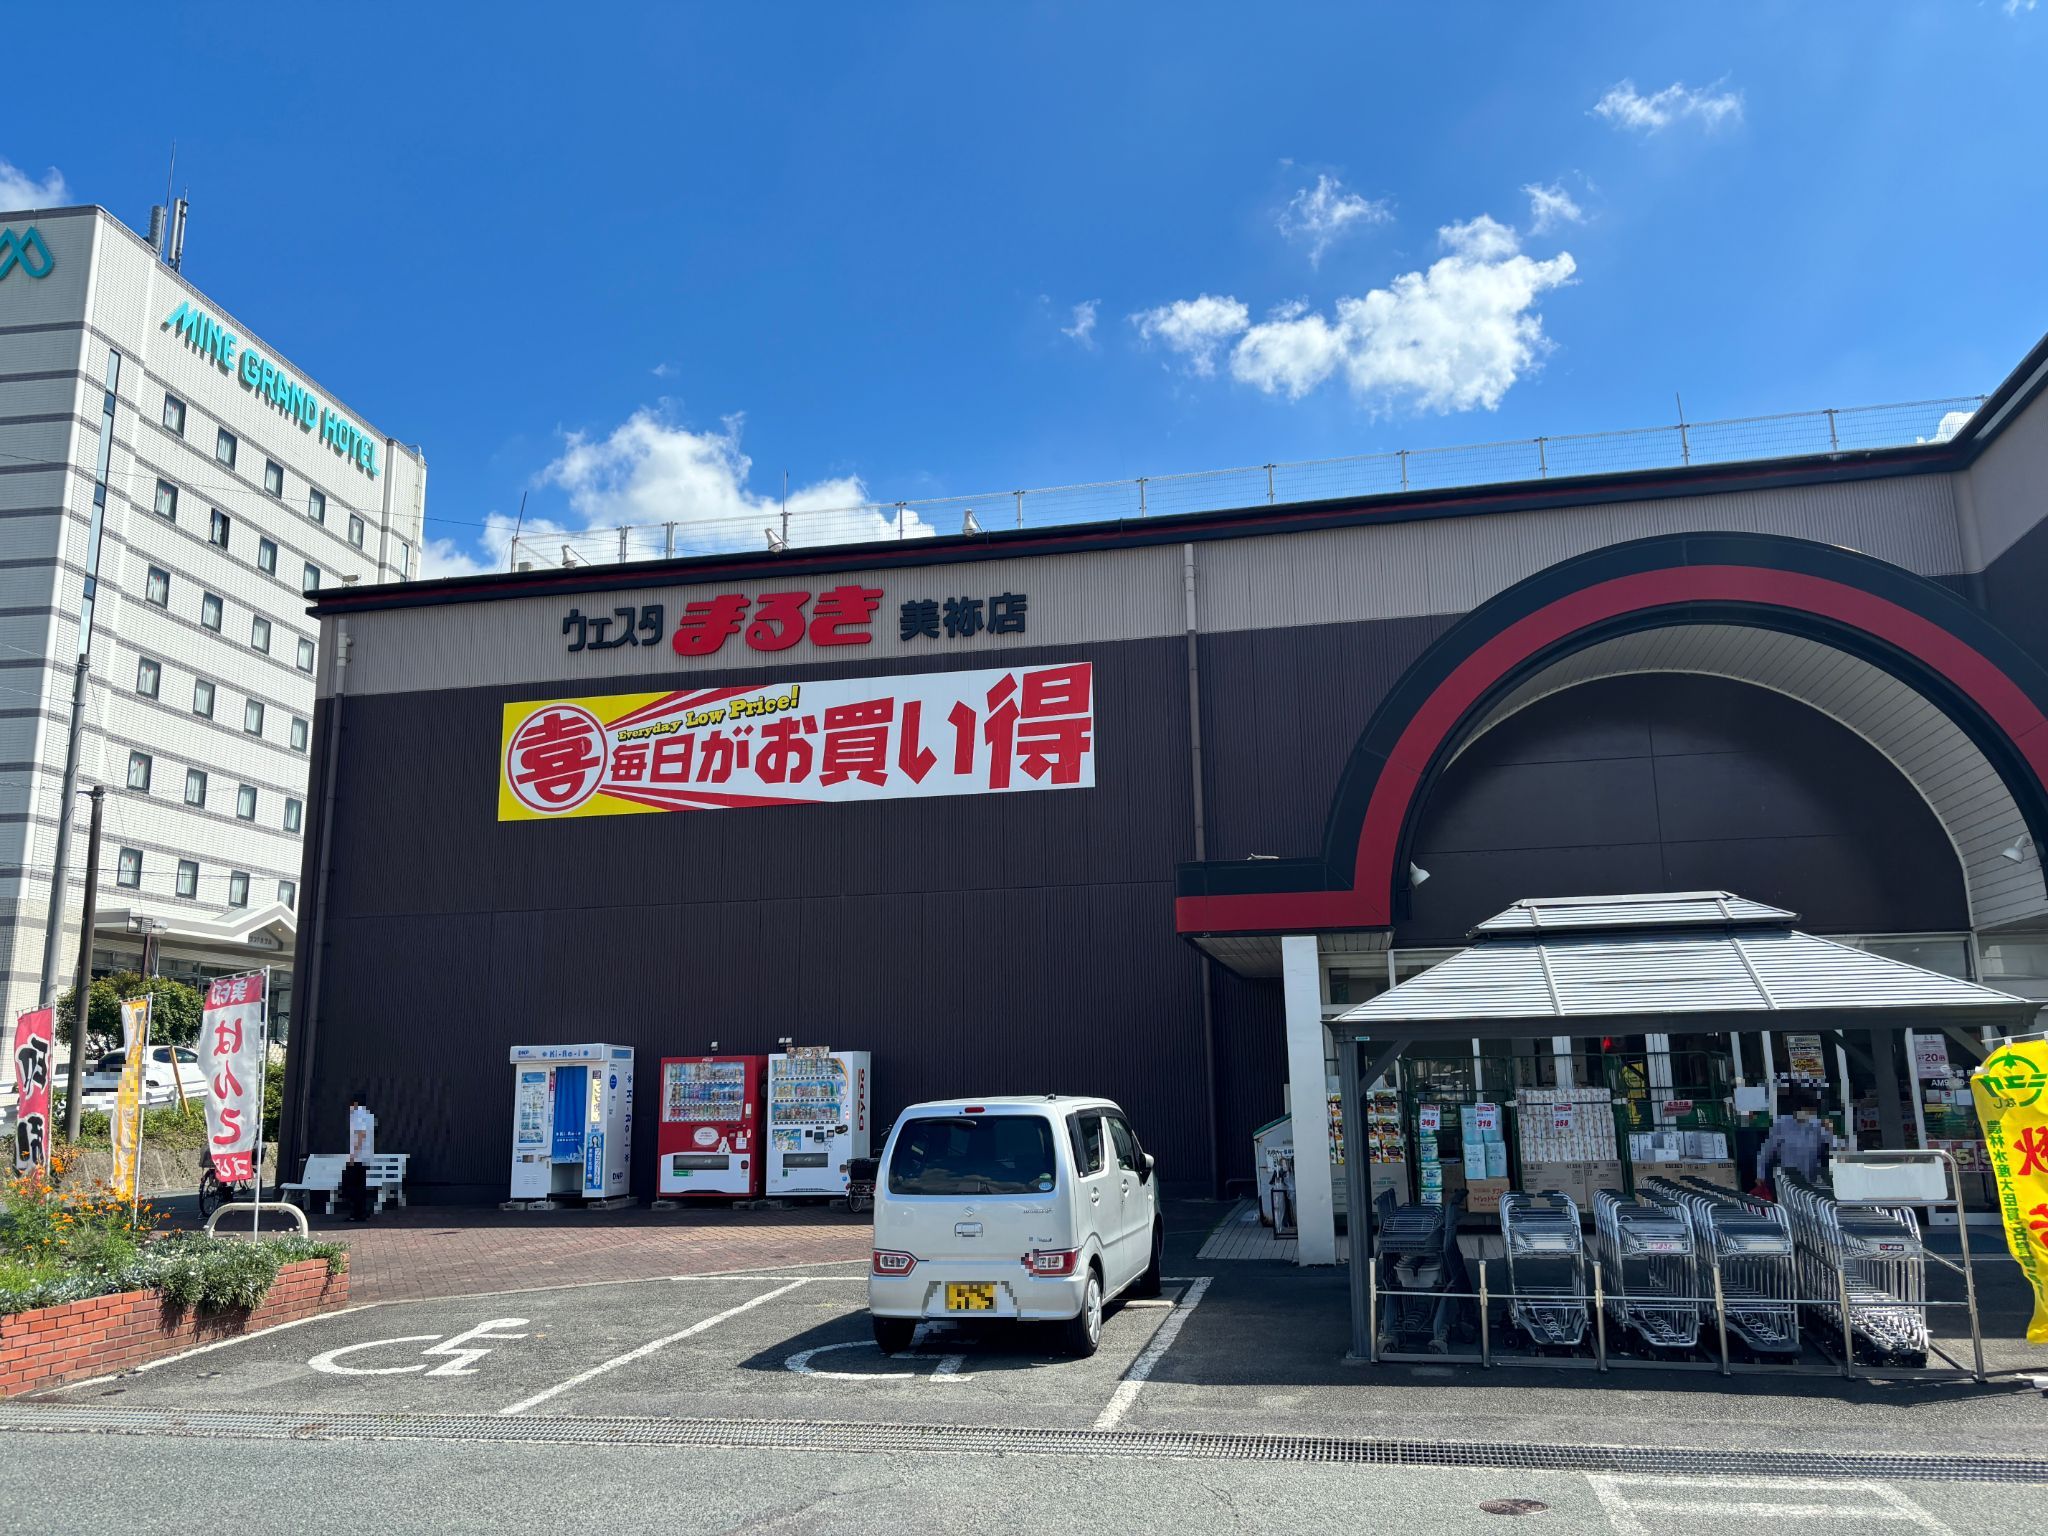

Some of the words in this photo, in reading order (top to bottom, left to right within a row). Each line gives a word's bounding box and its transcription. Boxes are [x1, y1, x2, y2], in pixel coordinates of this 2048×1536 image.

[166, 300, 237, 371] MINE
[243, 346, 319, 432] GRAND
[324, 409, 380, 477] HOTEL
[672, 585, 883, 656] まるき
[899, 592, 1027, 641] 美祢店
[610, 662, 1092, 790] 毎日がお買い得
[617, 719, 683, 741] Everyday
[686, 708, 726, 728] Low
[729, 685, 800, 719] Price!
